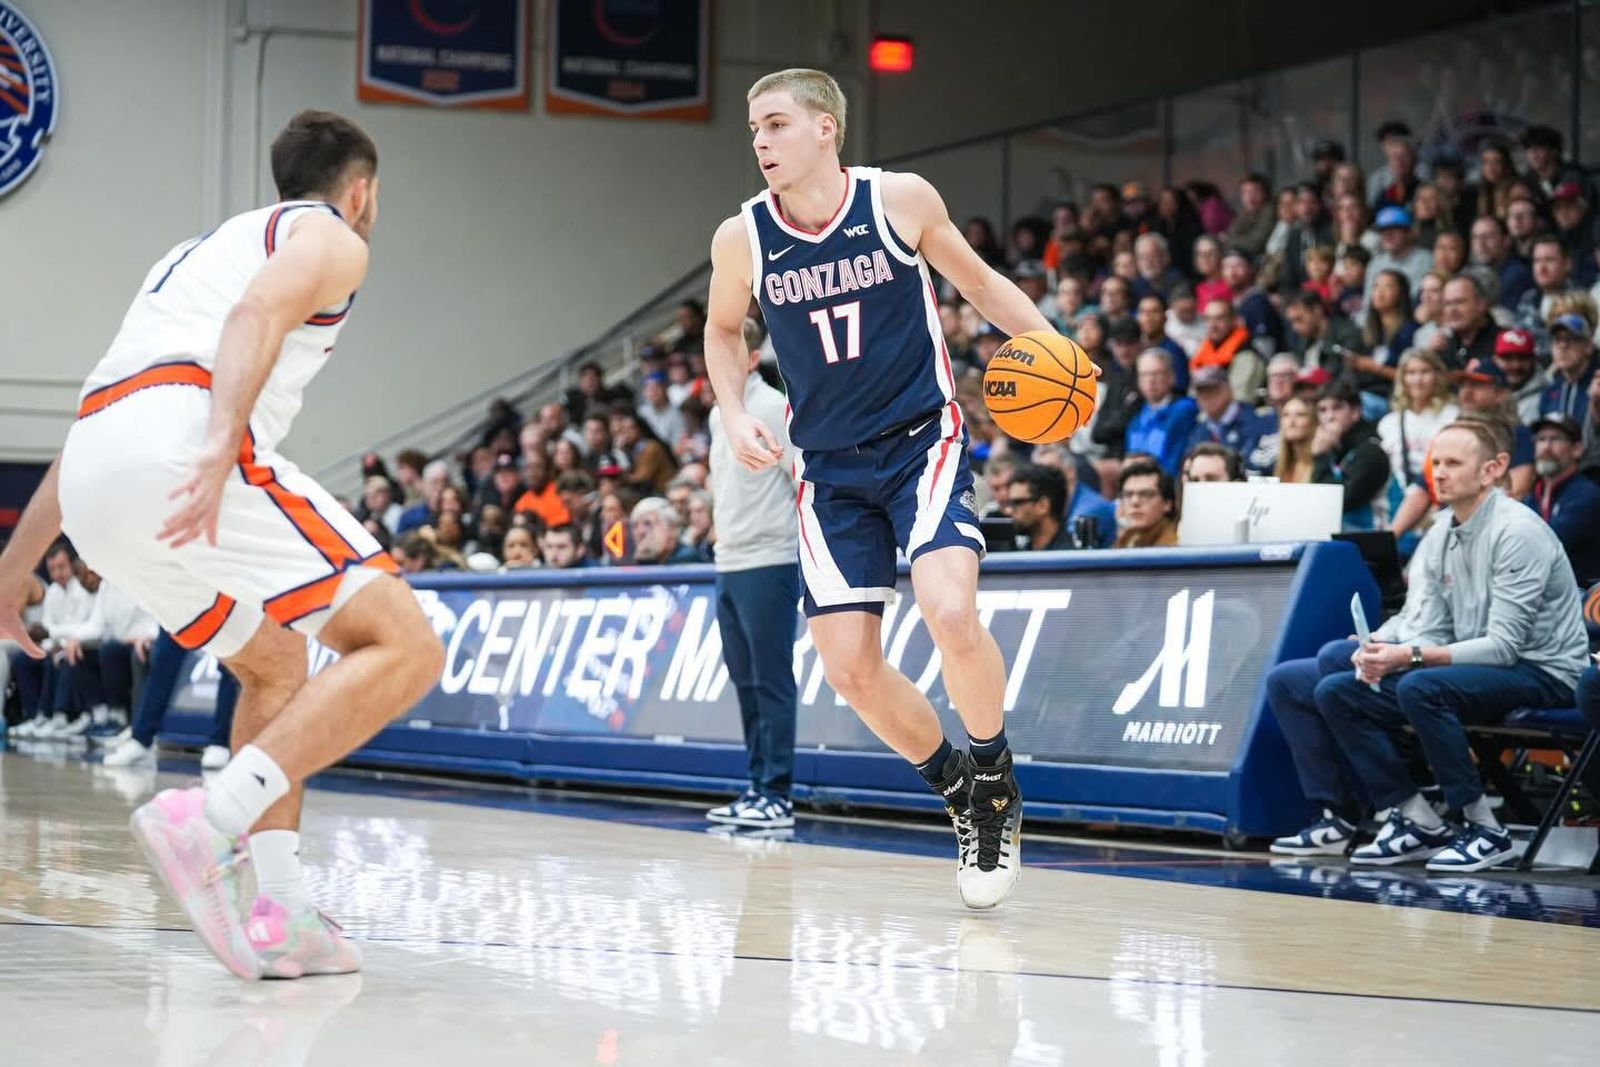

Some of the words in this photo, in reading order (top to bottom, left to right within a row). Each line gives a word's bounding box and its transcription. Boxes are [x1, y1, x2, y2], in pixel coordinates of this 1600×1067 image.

[765, 250, 894, 306] GONZAGA
[808, 301, 861, 365] 17
[441, 598, 670, 699] CENTER
[1122, 721, 1222, 746] MARRIOTT
